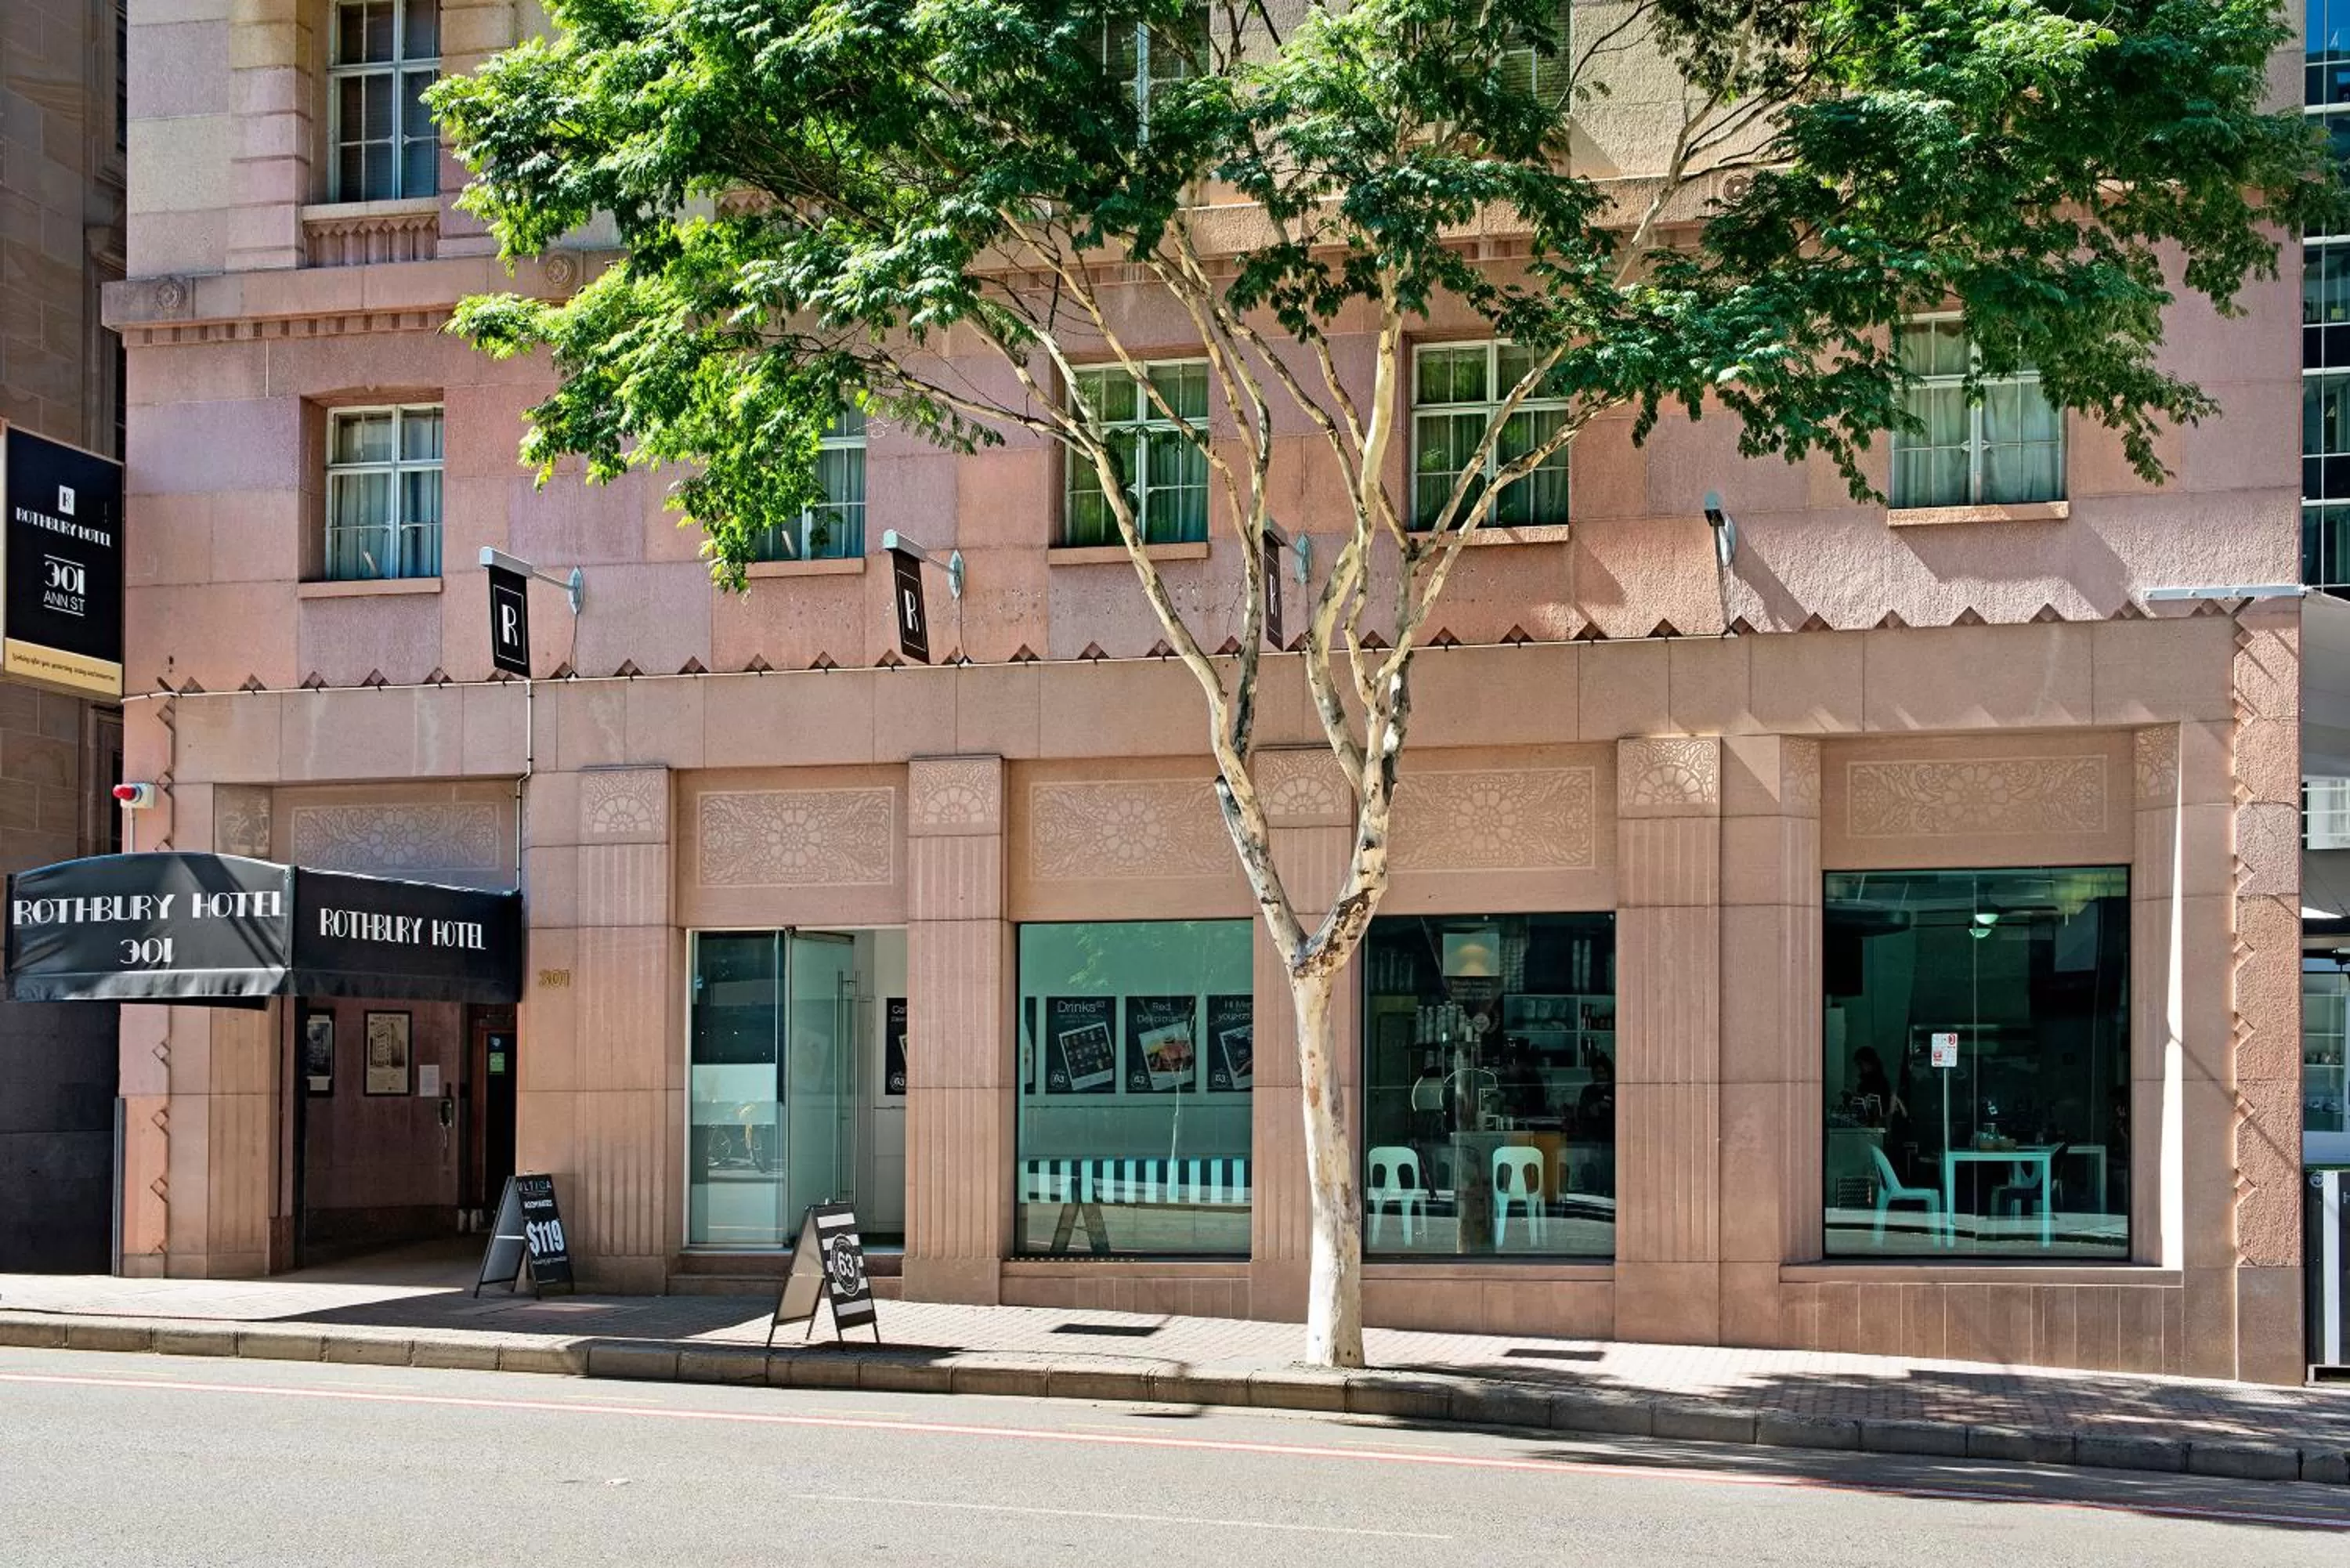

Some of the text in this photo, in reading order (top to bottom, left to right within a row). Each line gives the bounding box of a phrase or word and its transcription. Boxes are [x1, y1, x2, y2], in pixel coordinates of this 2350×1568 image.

[16, 506, 111, 547] ROTHBURY HOTEL
[45, 560, 85, 595] 301
[43, 590, 85, 612] ANN ST
[903, 588, 919, 632] R
[501, 604, 518, 646] R
[13, 891, 287, 925] ROTHBURY HOTEL
[320, 907, 487, 950] ROTHBURY HOTEL
[119, 938, 173, 964] 301
[538, 970, 570, 988] 301
[526, 1219, 566, 1257] $119
[837, 1251, 855, 1278] 63
